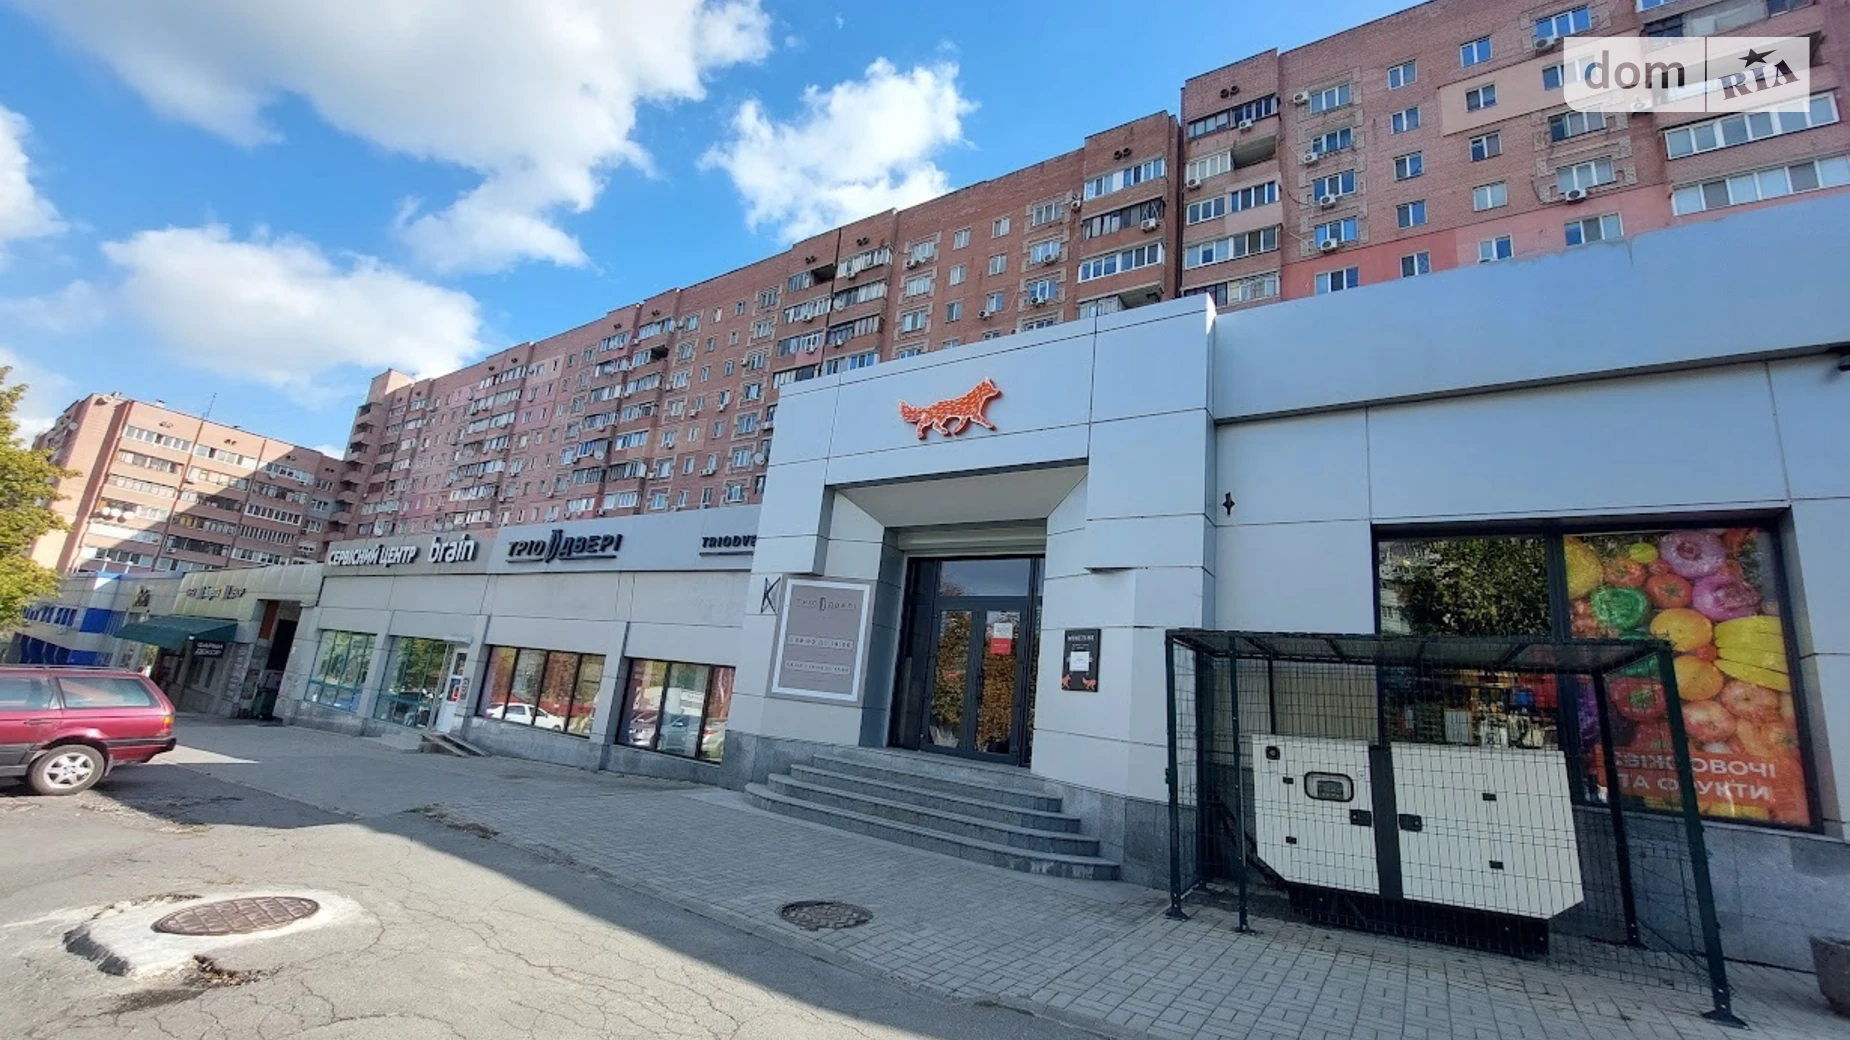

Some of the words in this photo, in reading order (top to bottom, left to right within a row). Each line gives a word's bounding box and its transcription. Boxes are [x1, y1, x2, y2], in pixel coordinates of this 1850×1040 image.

[328, 544, 380, 566] СЕРВІСНИЙ
[378, 545, 418, 567] ЦЕНТР
[428, 533, 477, 563] brain
